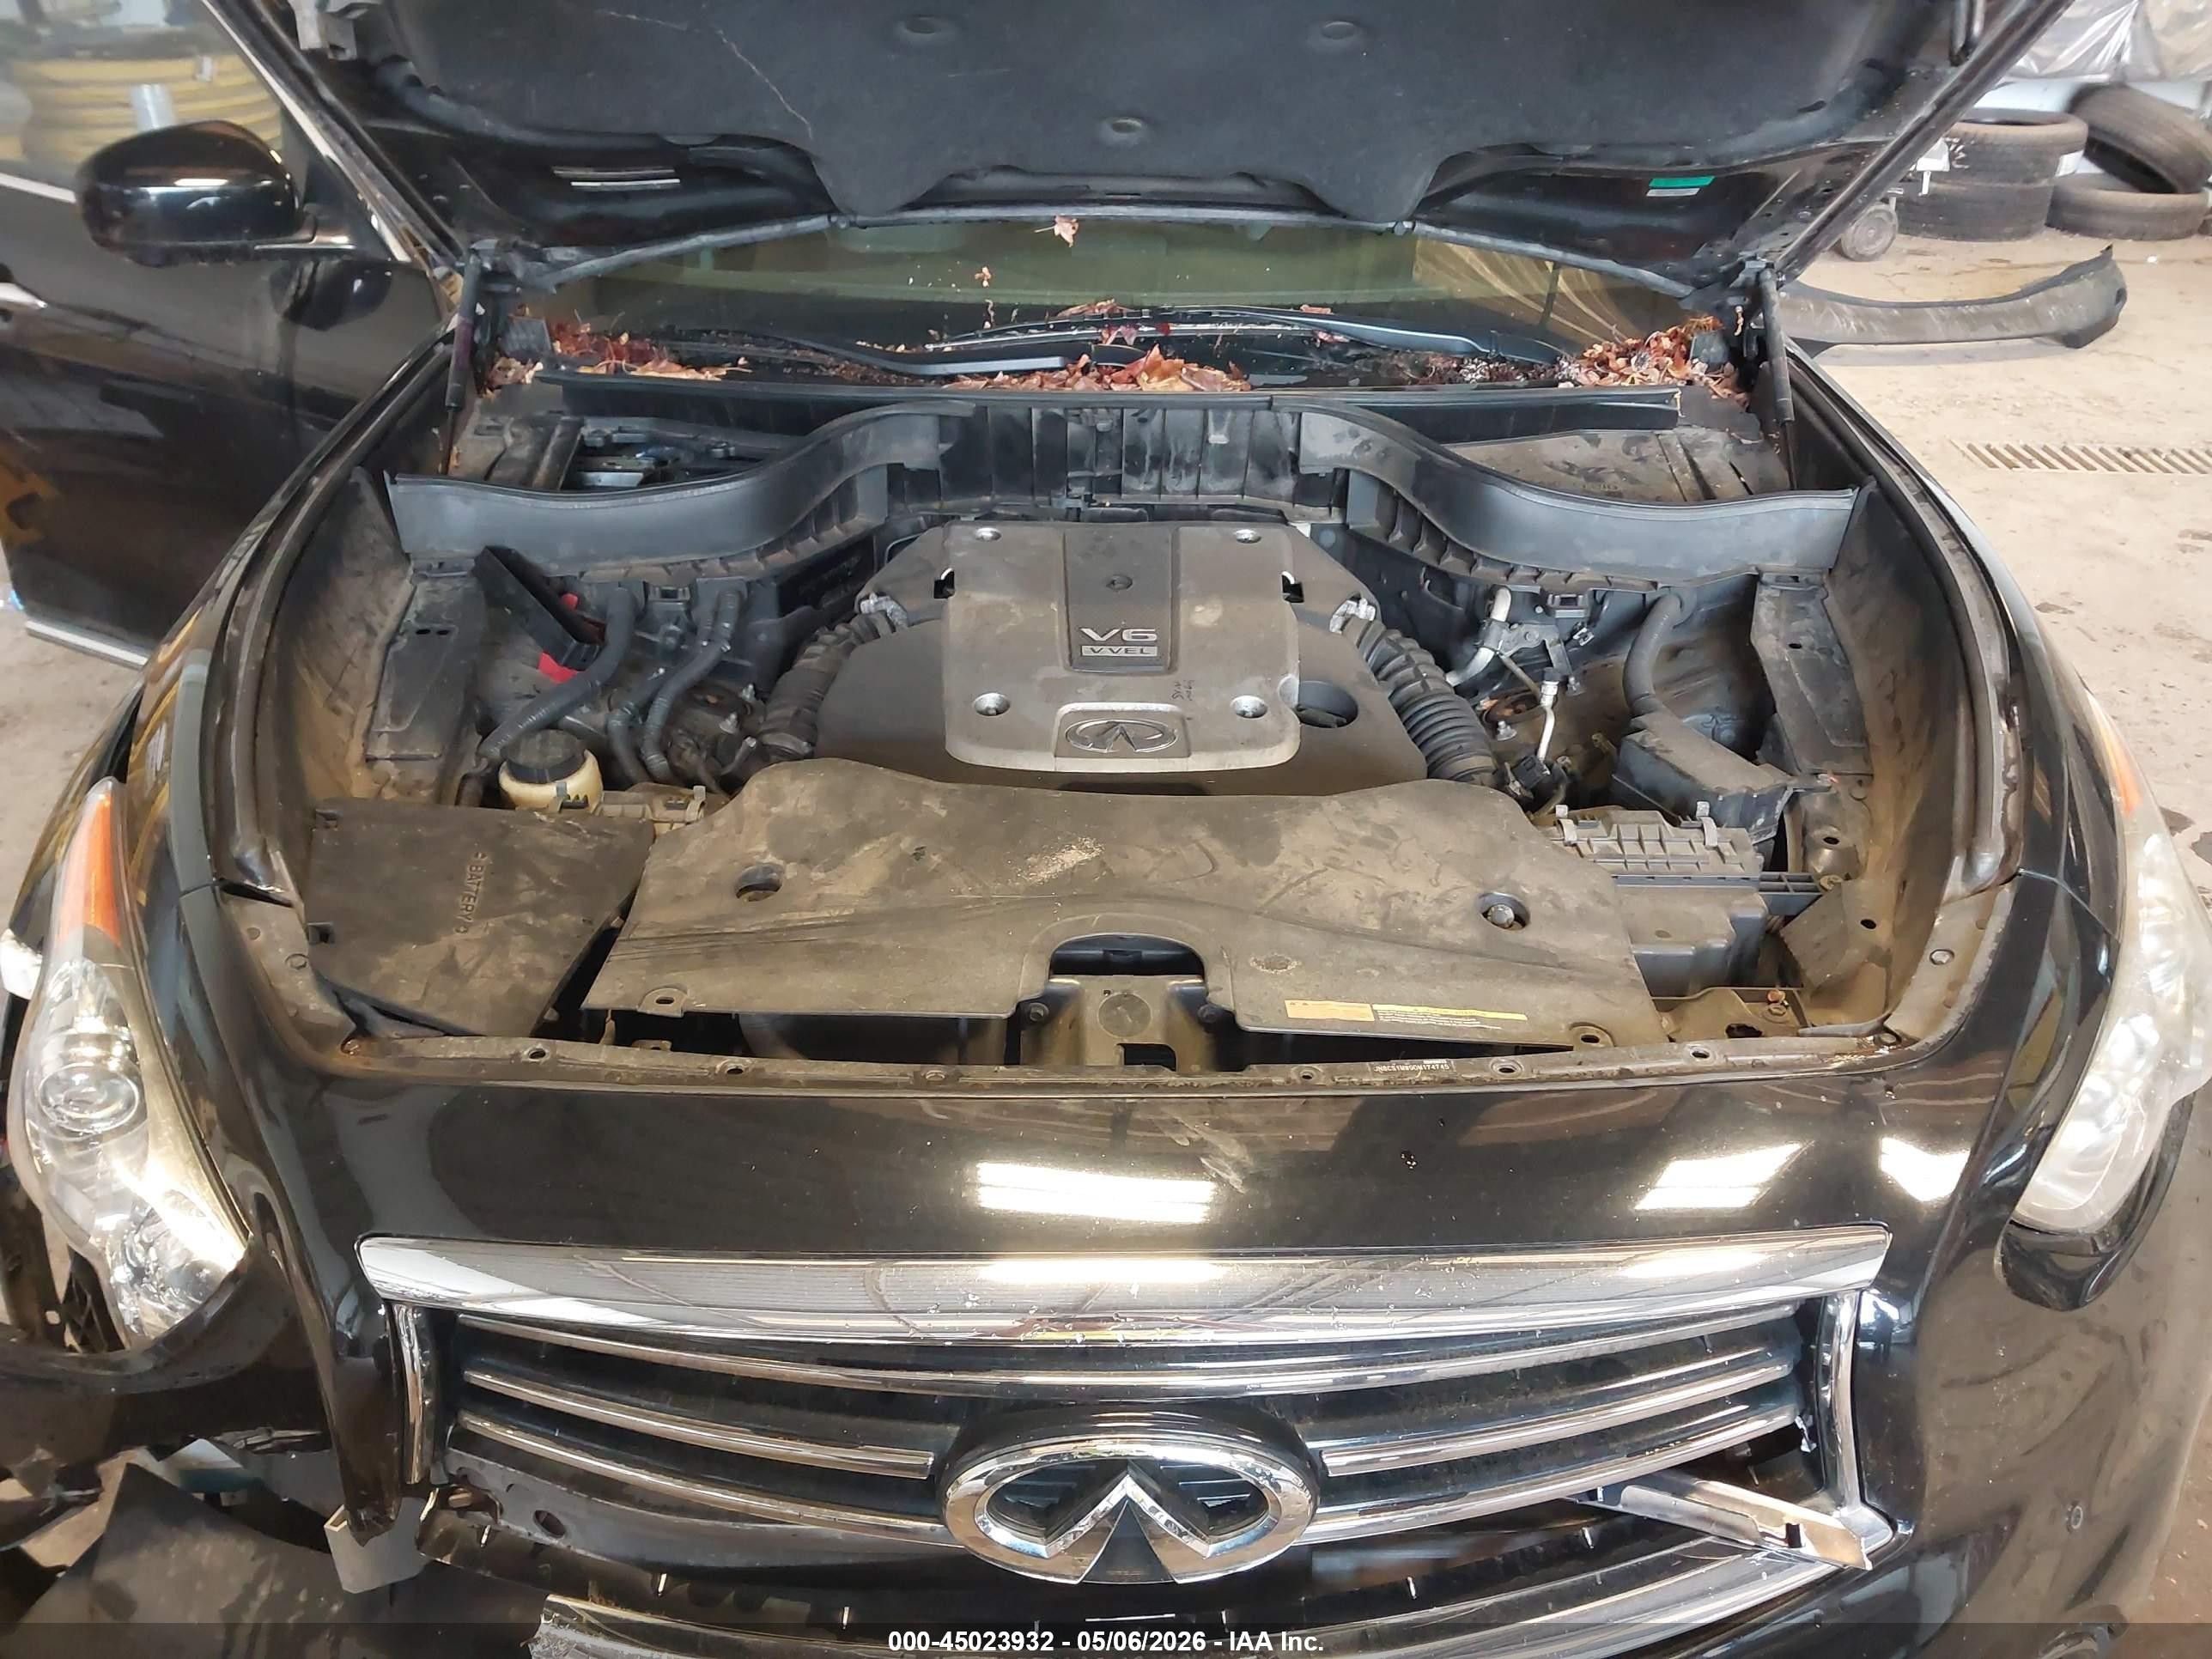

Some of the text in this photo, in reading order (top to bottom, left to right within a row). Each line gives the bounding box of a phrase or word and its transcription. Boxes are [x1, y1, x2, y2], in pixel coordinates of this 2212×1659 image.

[1080, 628, 1158, 641] V6
[1090, 647, 1151, 655] VVEL
[457, 865, 484, 922] BATTERY
